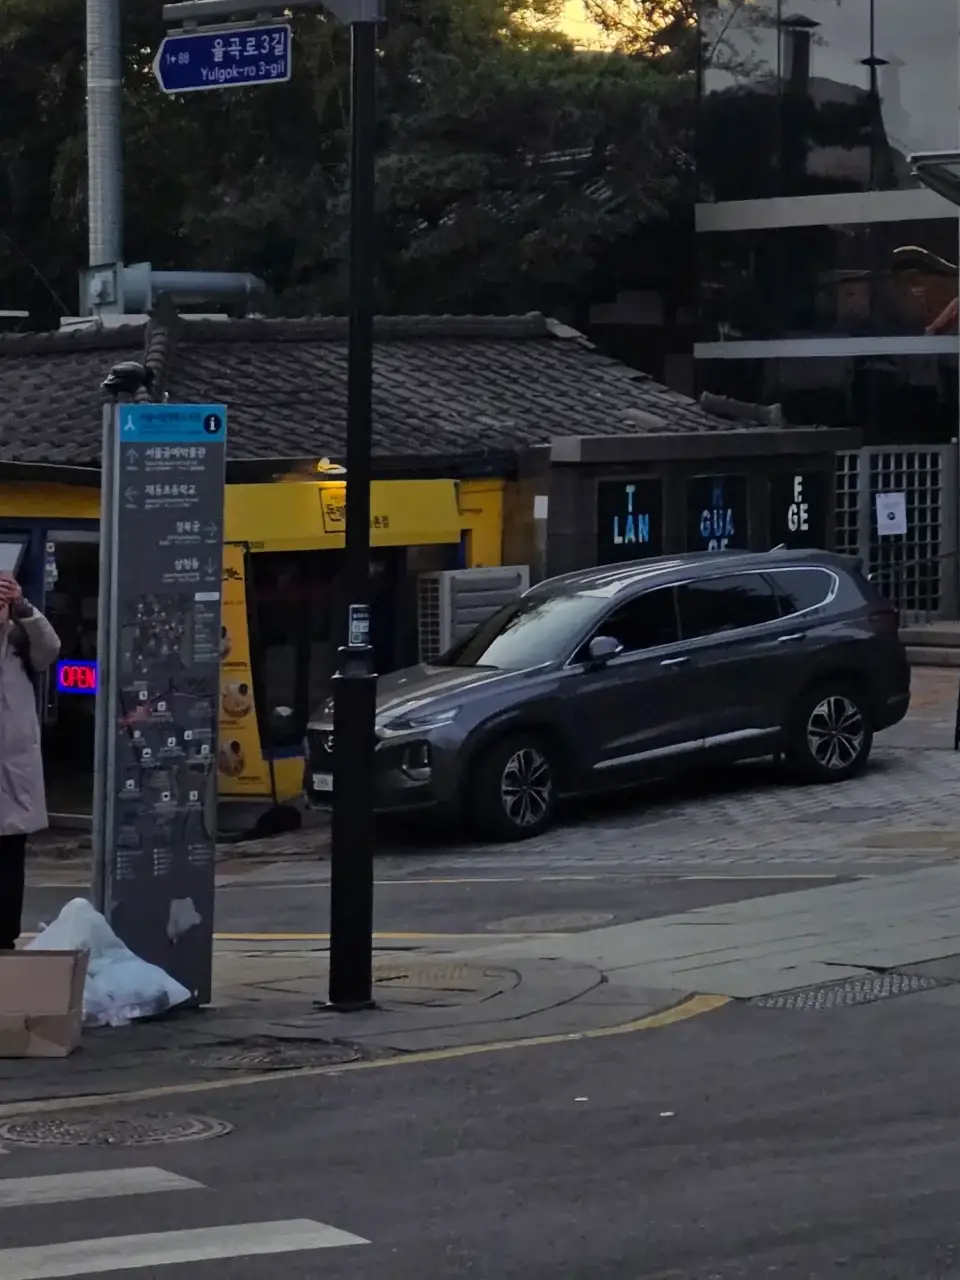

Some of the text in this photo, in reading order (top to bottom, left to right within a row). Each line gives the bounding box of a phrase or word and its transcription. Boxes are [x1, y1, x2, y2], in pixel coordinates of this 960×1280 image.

[211, 31, 285, 63] 율곡로3길
[200, 59, 285, 82] Yulgok-ro 3-gil
[793, 475, 803, 503] E
[612, 513, 650, 545] LAN
[699, 507, 735, 538] GUA
[787, 503, 810, 532] GE
[60, 665, 97, 688] OPEN
